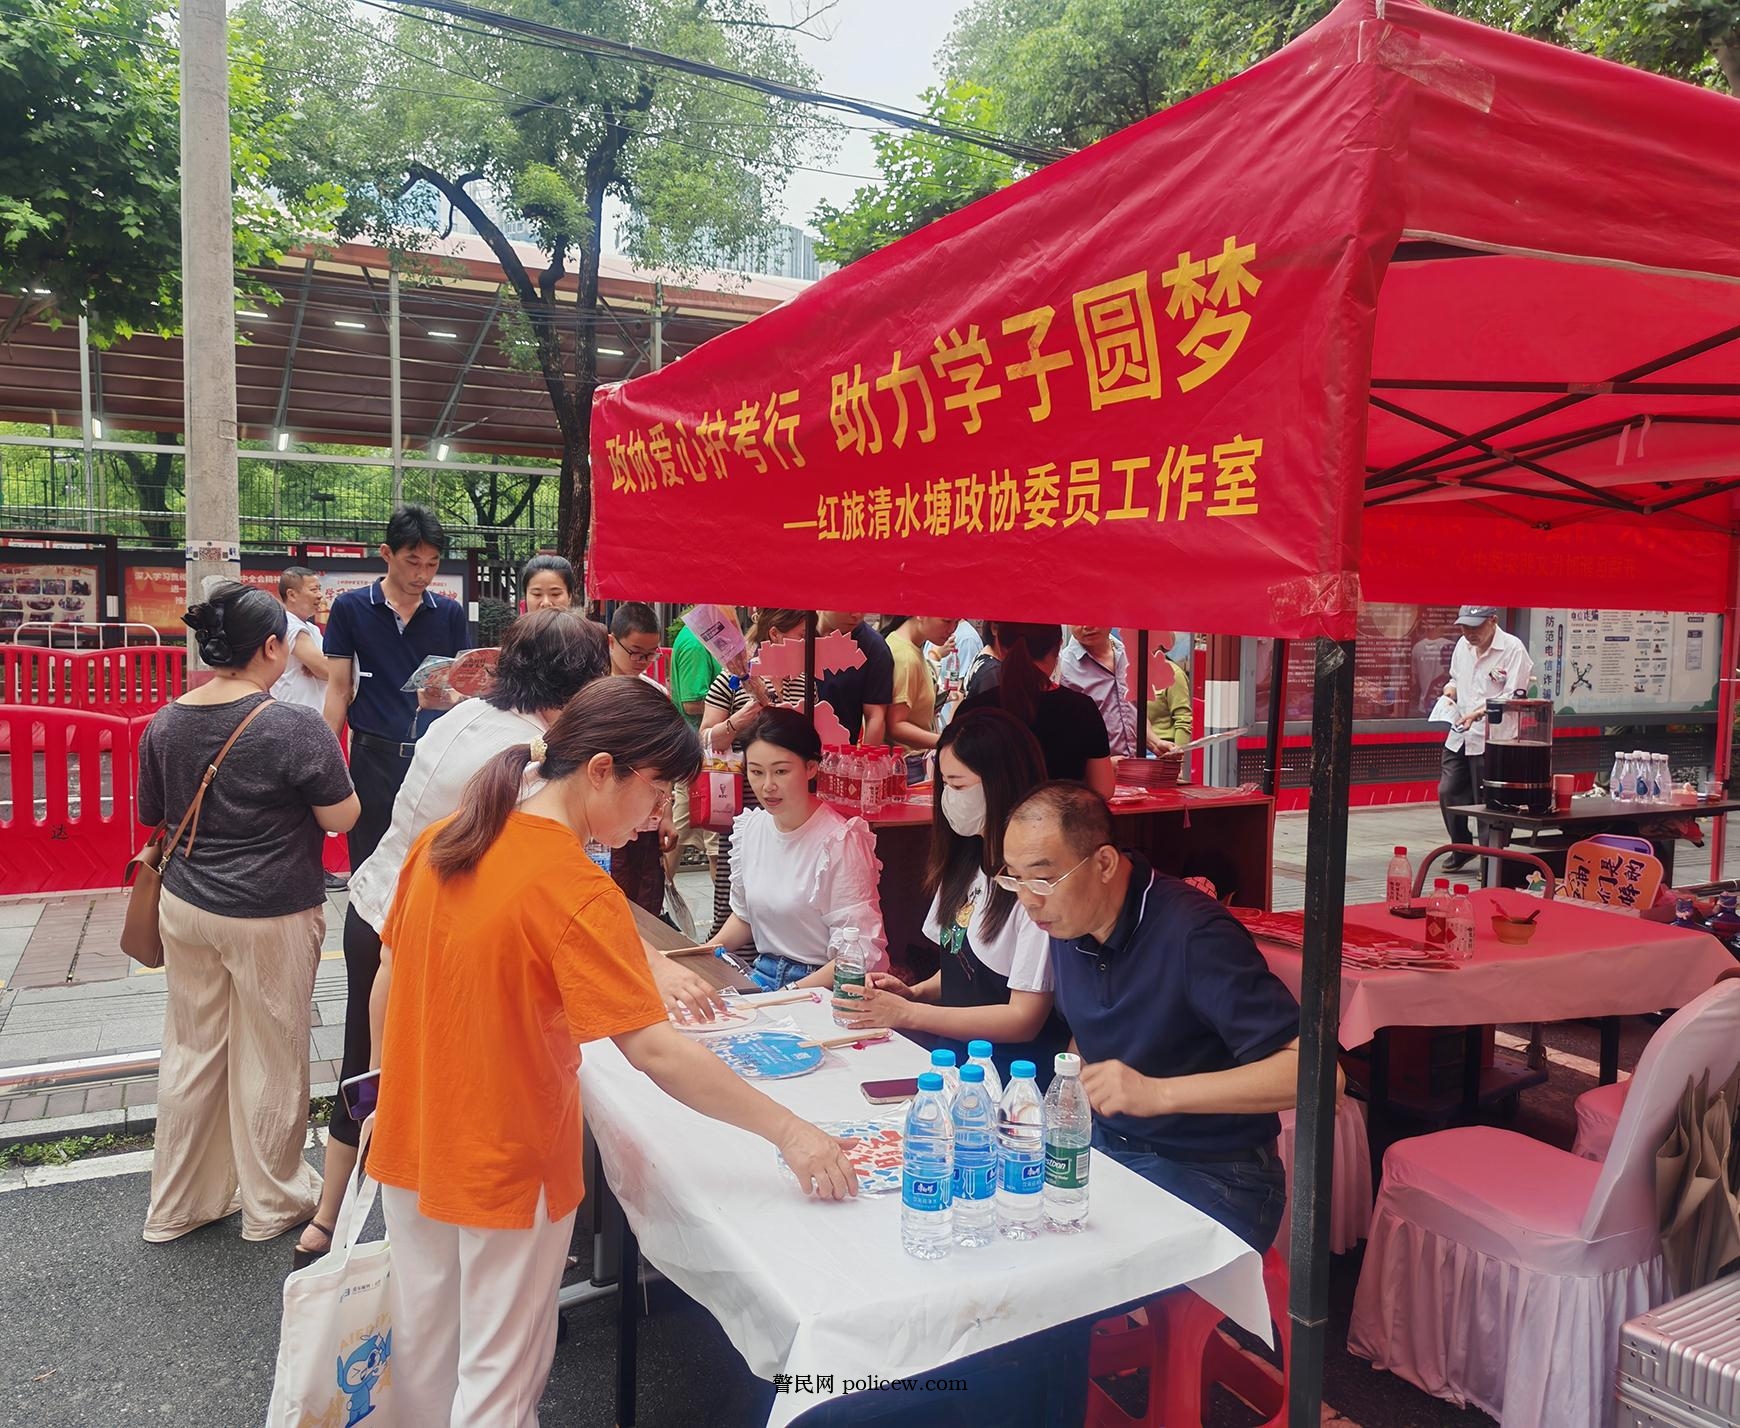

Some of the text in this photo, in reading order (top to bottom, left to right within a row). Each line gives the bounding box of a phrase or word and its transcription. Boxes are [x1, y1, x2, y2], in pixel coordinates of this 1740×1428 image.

[604, 235, 1263, 497] 政协爱心护考行 助力学子圆梦
